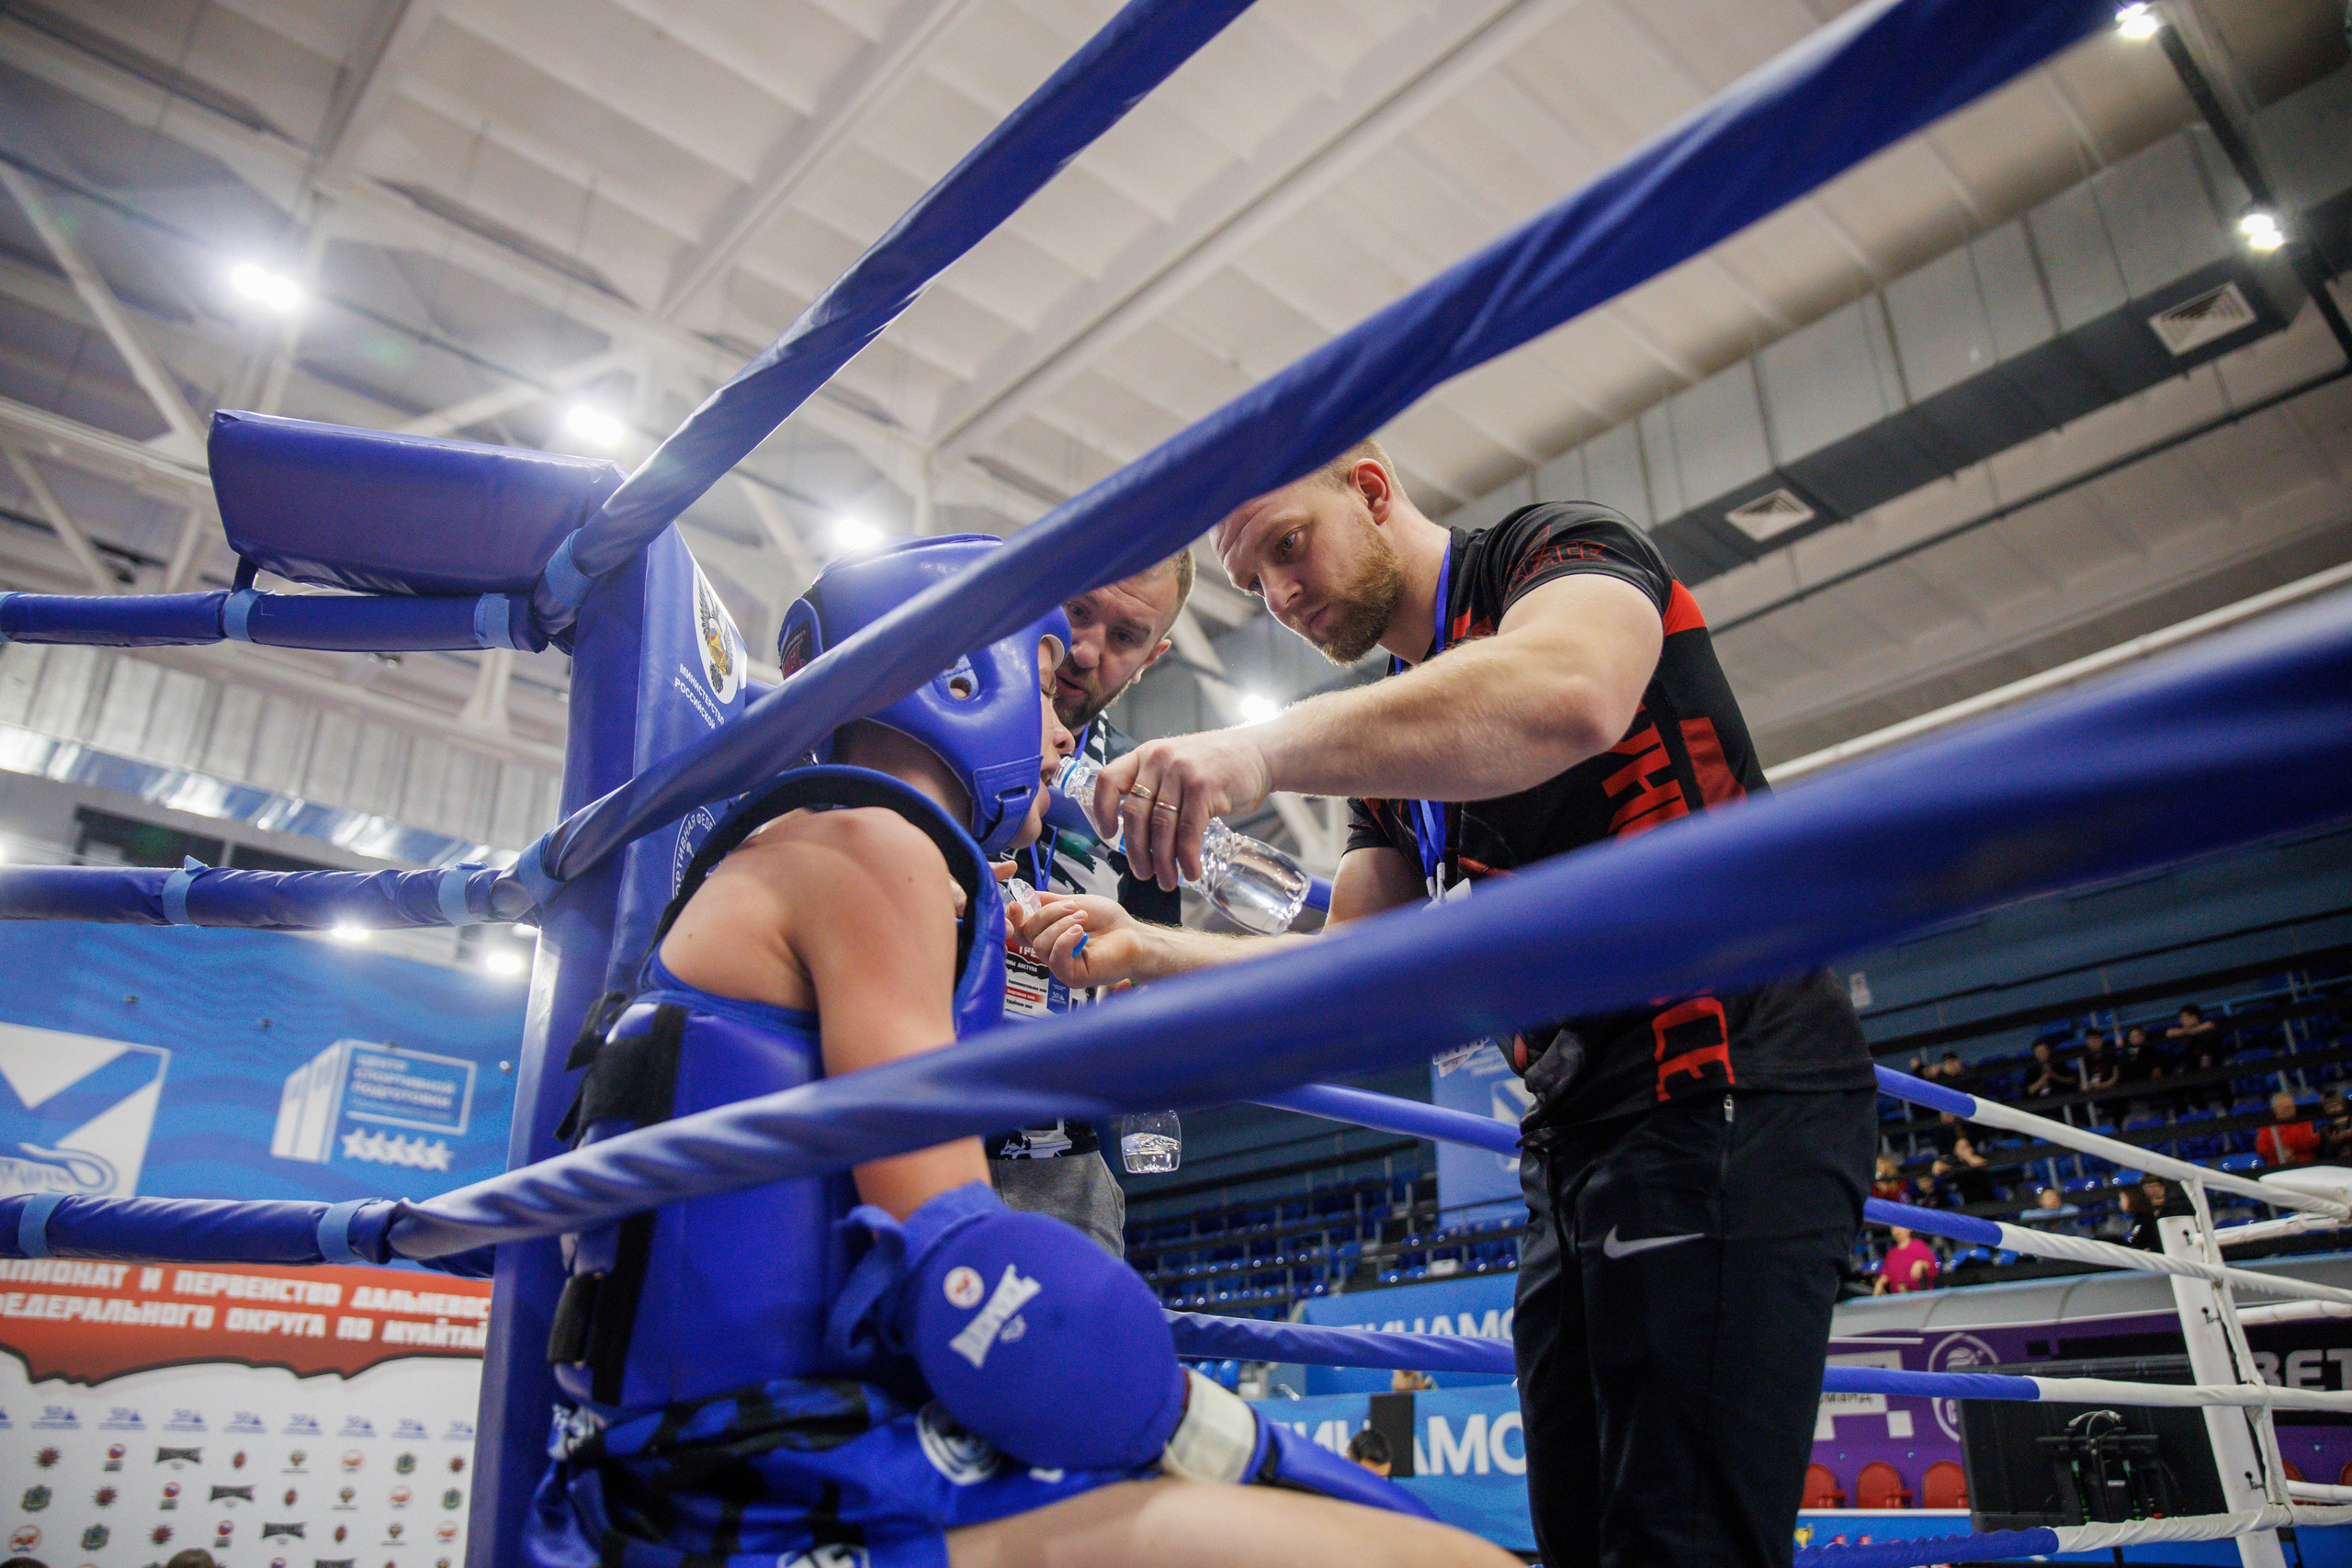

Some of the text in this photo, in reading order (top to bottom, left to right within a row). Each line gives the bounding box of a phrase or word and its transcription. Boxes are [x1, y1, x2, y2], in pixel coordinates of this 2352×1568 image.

[675, 677, 716, 730] РОССИЙСКОЙ
[680, 663, 725, 725] МИНИСТЕРСТВО
[140, 1267, 164, 1292] И
[173, 1269, 343, 1308] ПЕРВЕНСТВО
[0, 1292, 216, 1332] ЕДЕРАЛЬНОГО
[225, 1307, 327, 1338] ОКРУГА
[335, 1315, 374, 1342] ПО
